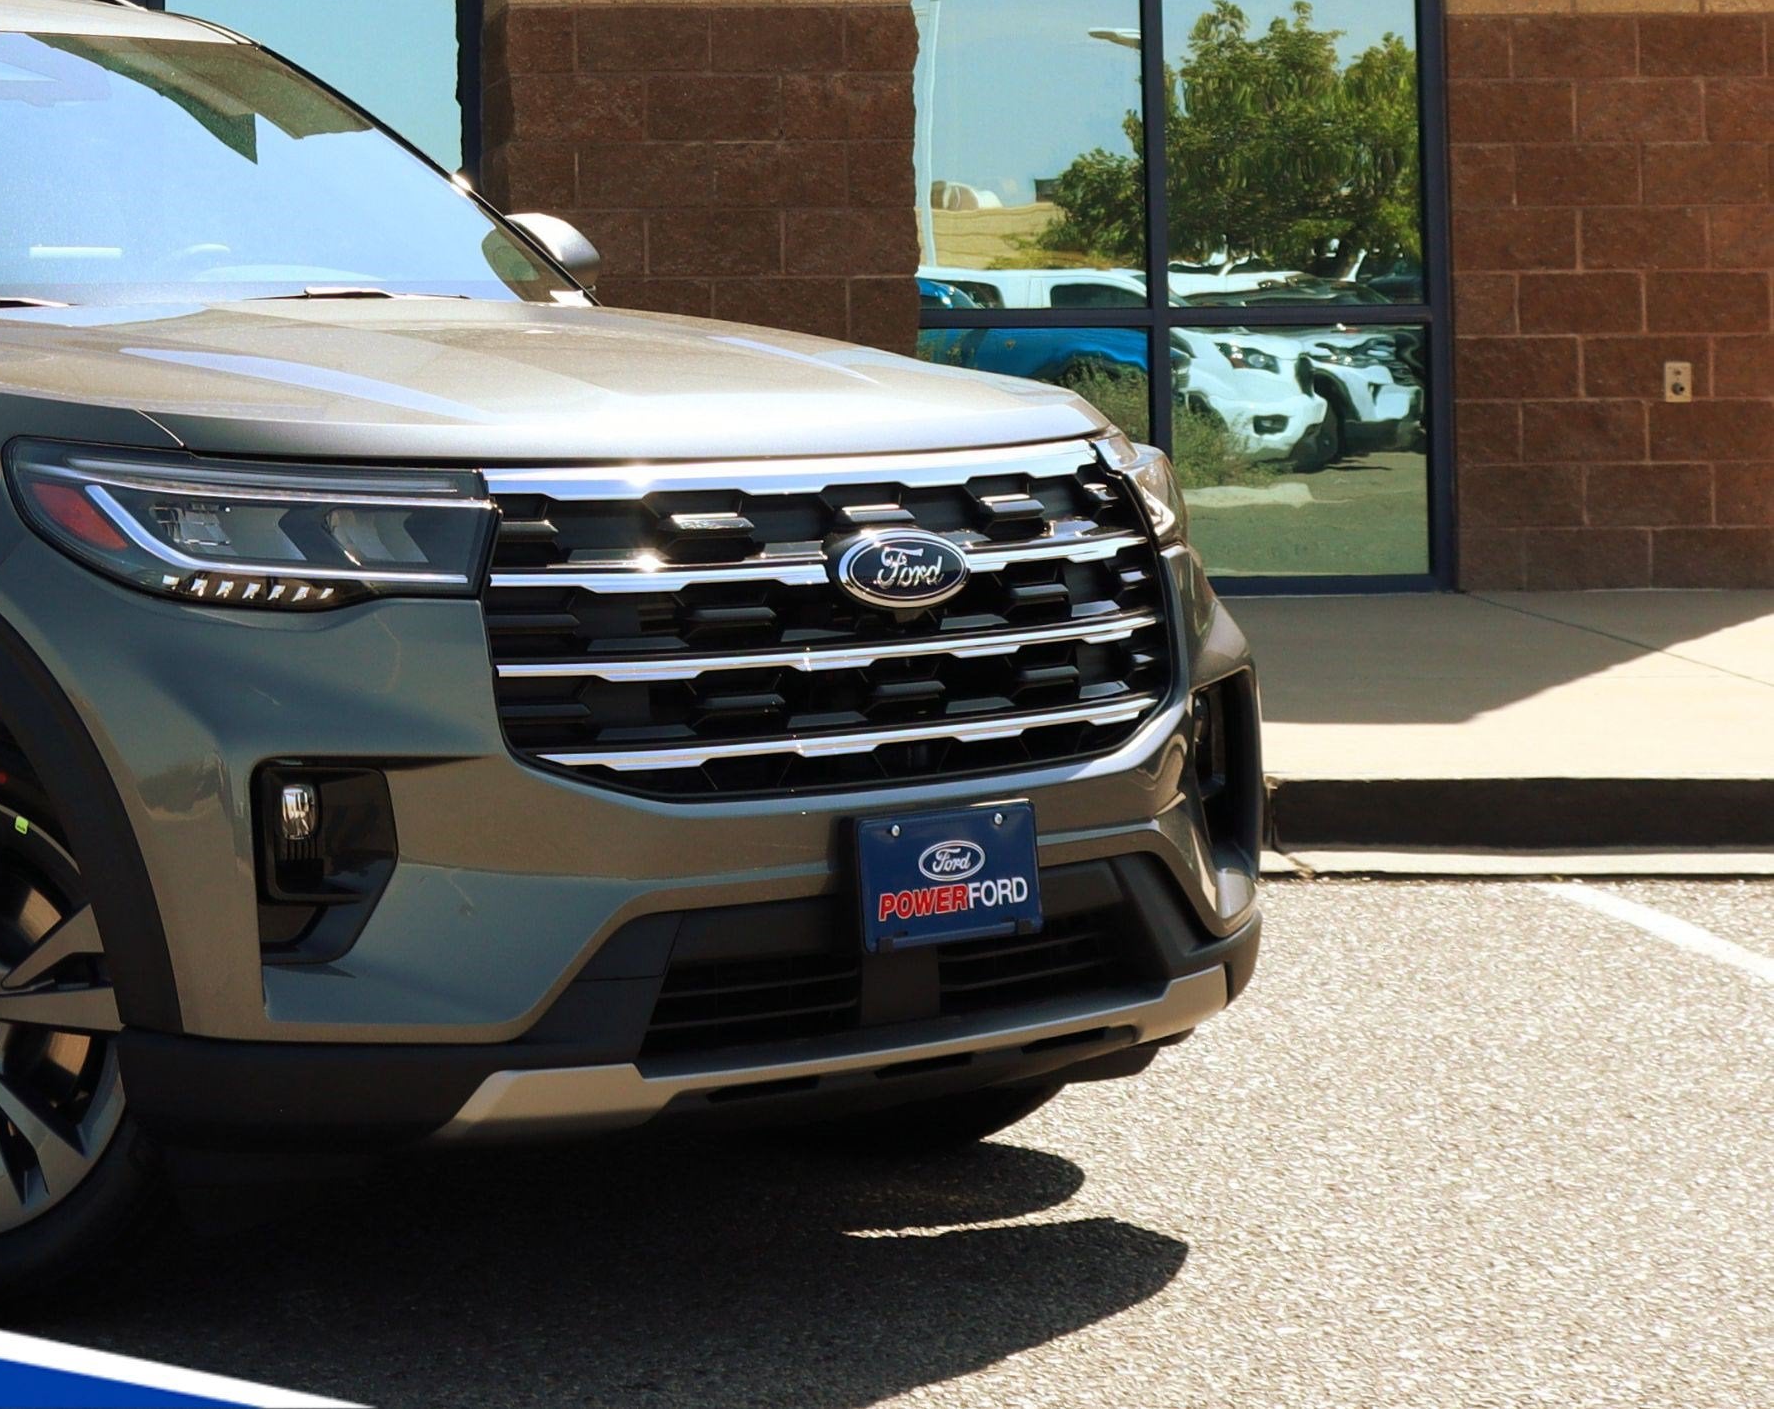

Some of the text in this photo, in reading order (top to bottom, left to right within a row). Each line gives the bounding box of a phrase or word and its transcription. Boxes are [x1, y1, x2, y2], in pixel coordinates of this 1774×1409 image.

[875, 547, 944, 588] Ford
[932, 847, 971, 873] Ford
[879, 877, 1028, 922] POWERFORD
